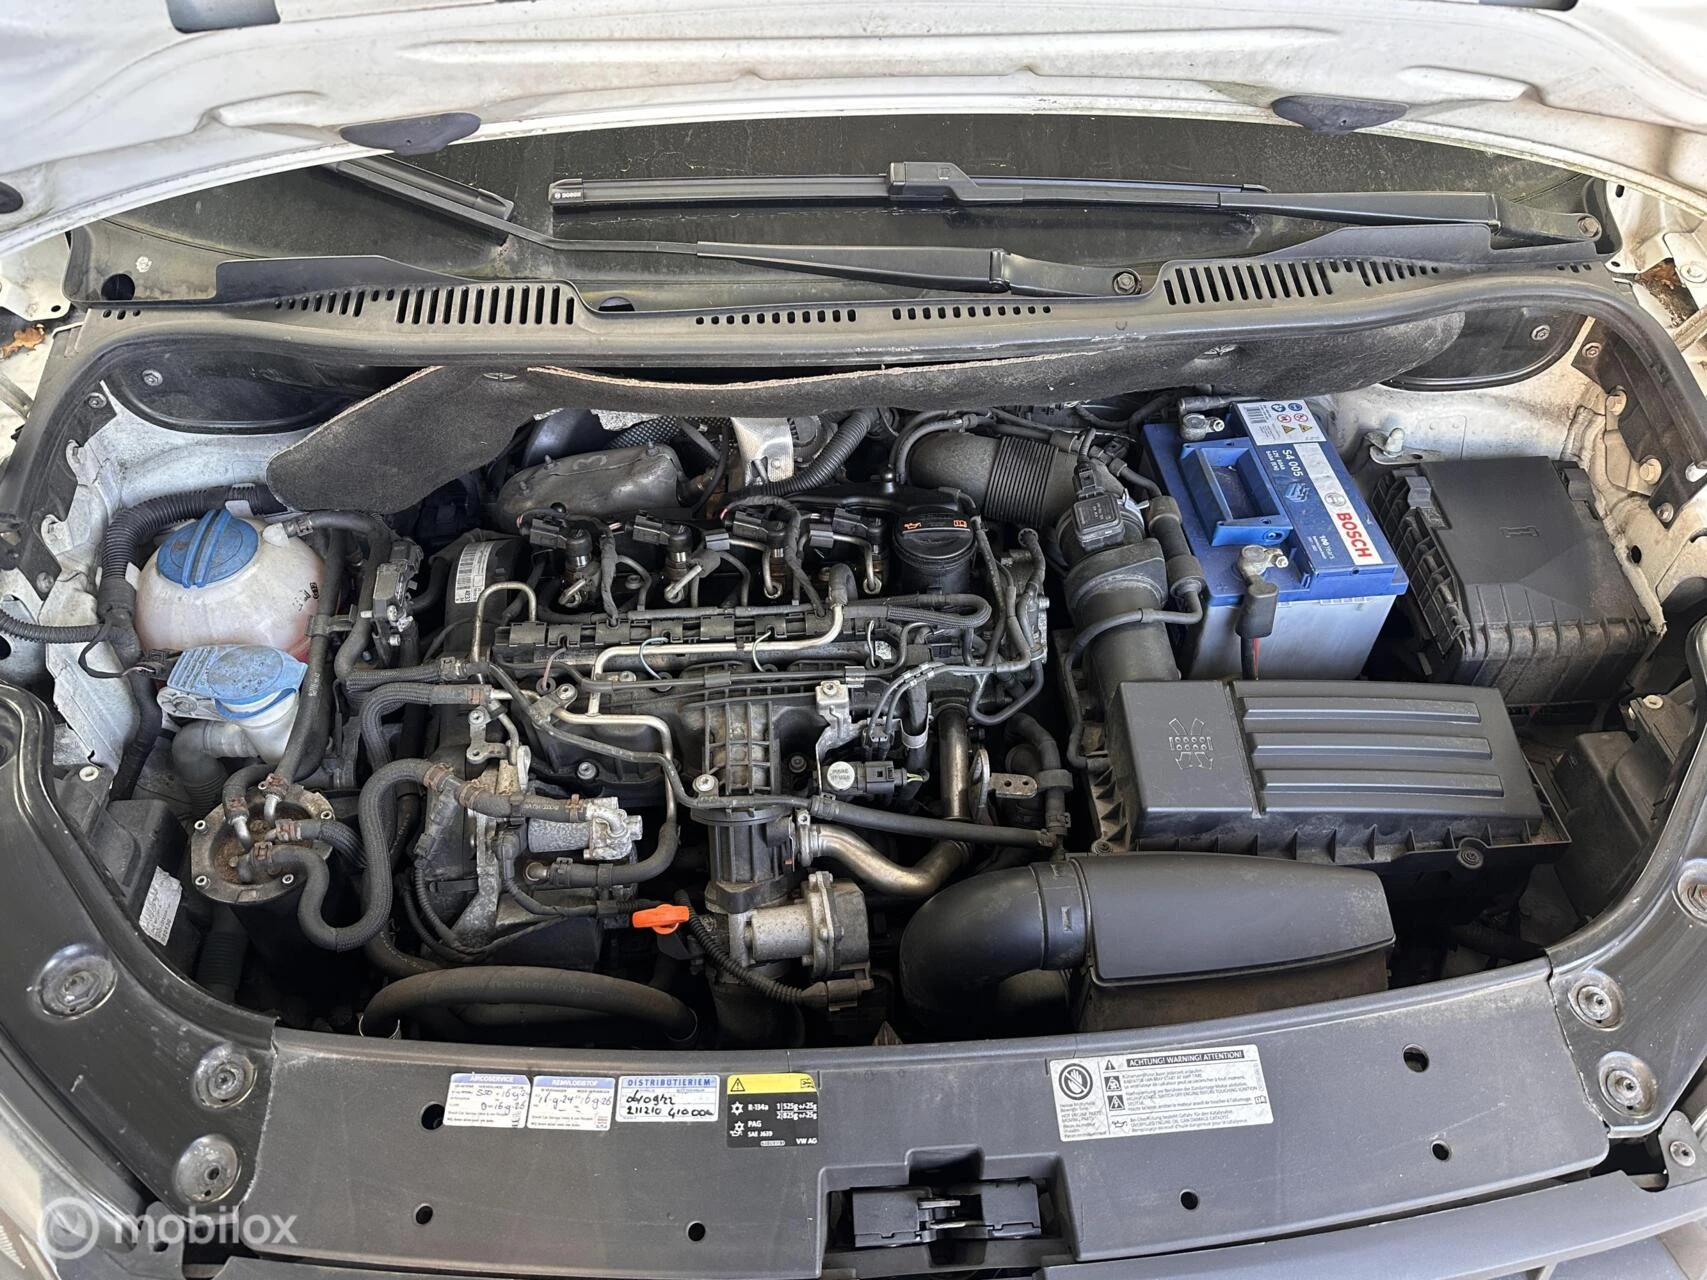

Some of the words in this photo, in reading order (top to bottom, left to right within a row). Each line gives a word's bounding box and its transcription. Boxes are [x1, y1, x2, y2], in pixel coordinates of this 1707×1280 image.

[1282, 449, 1295, 460] S4
[1288, 461, 1304, 477] 005
[1336, 512, 1373, 558] BOSCH
[1129, 1058, 1165, 1067] ACHTUNG!
[1167, 1054, 1202, 1064] WARNING!
[1204, 1051, 1243, 1060] ATTENTION!
[627, 1078, 711, 1086] DISTRIBUTIERIEM
[748, 1120, 762, 1128] PAG
